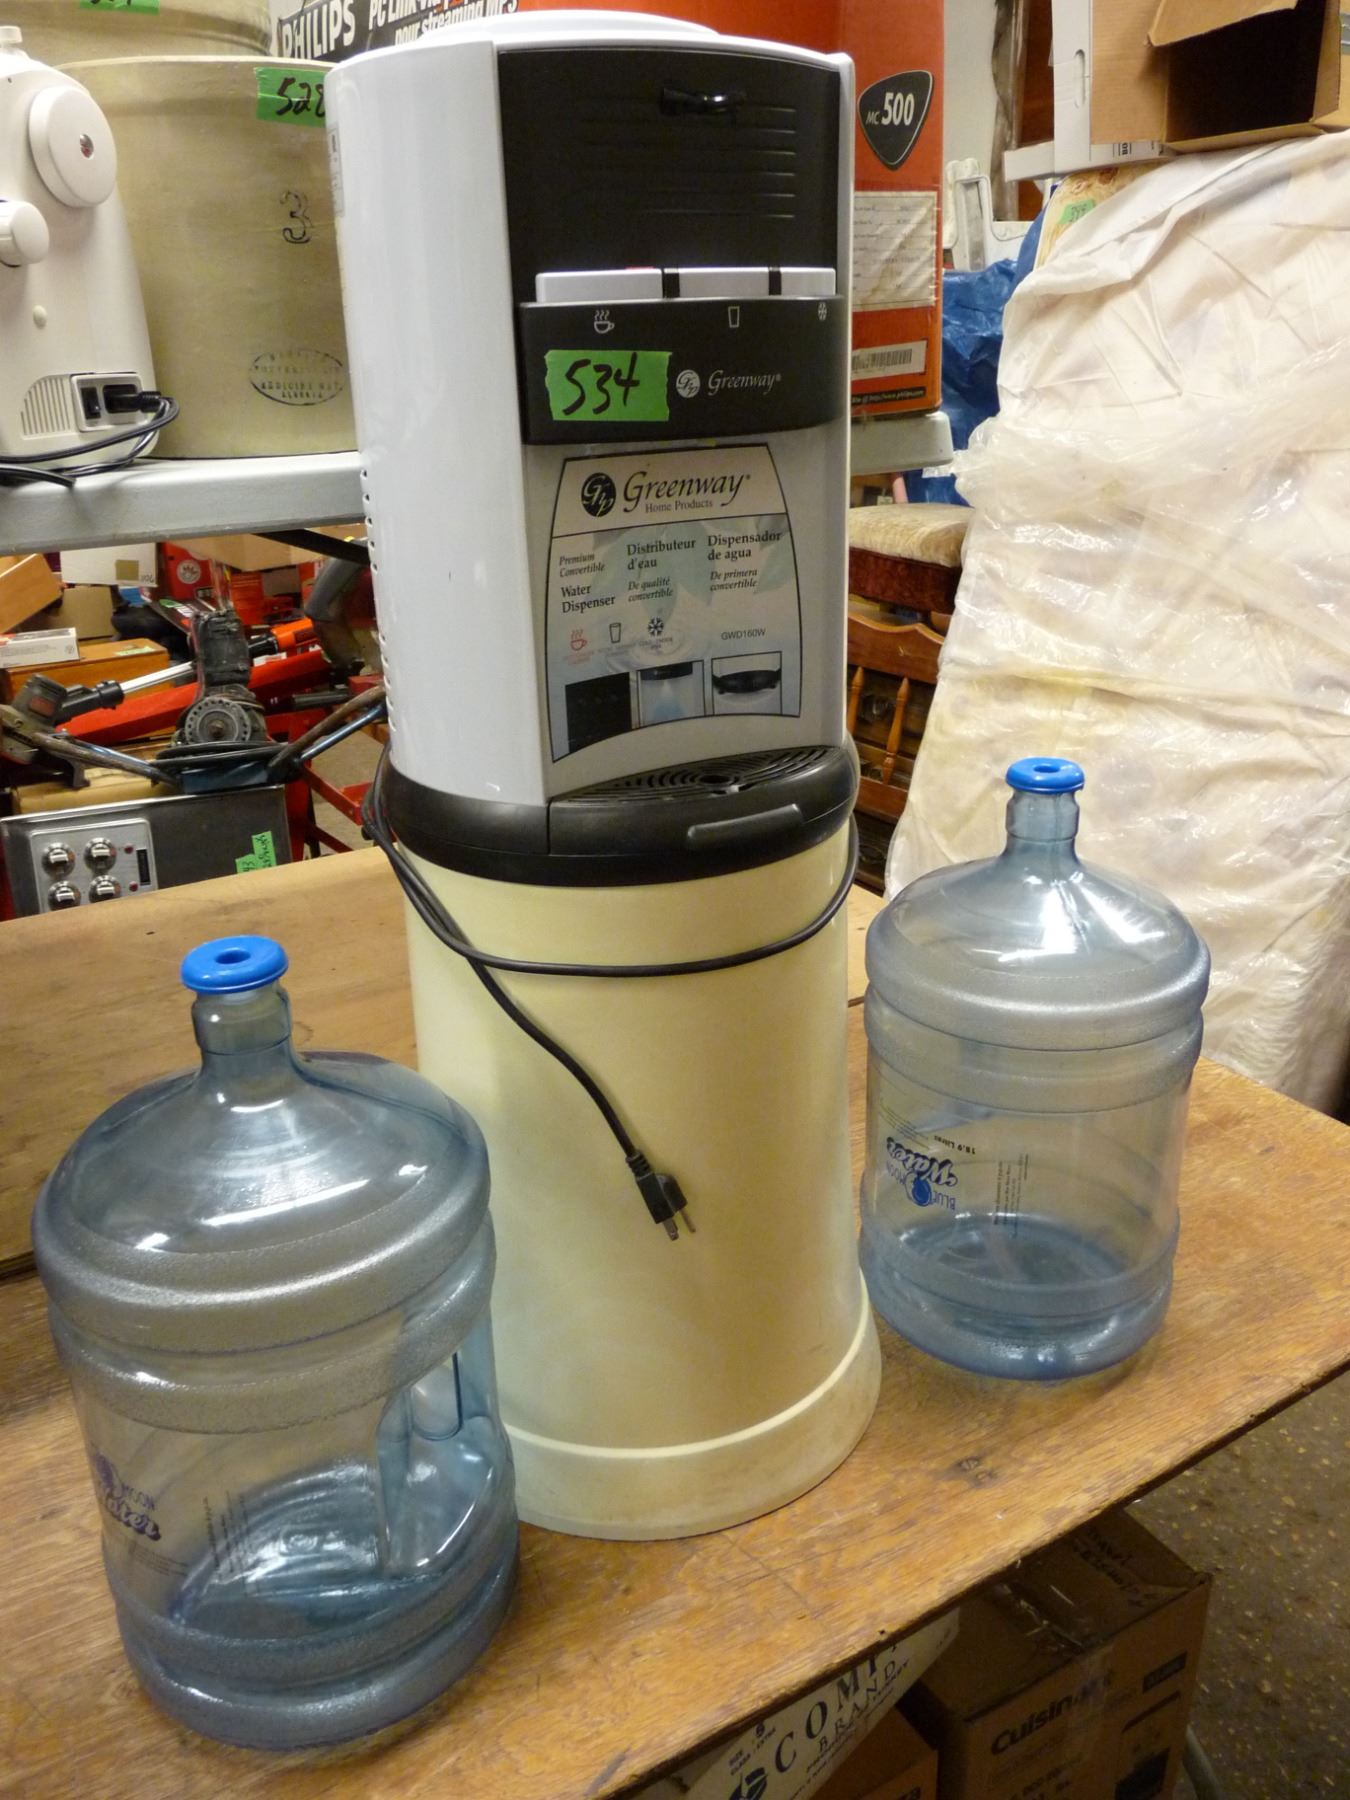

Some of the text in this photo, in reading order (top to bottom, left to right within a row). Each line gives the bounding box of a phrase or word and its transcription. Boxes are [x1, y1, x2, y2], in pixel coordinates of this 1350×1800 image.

[282, 0, 356, 59] PHILIPS
[866, 91, 915, 126] MC 500
[562, 352, 641, 416] 534
[645, 498, 713, 514] Home Products
[626, 538, 697, 556] Distributeur
[707, 530, 783, 549] Dispensador
[559, 551, 595, 567] Premium
[707, 549, 752, 562] de agua
[559, 562, 605, 578] Convertible
[627, 557, 657, 571] d'eau
[628, 575, 671, 591] De qualité
[710, 568, 758, 583] De primera
[560, 584, 592, 599] Water
[709, 578, 758, 592] convertible
[628, 587, 674, 602] convertible
[562, 594, 616, 614] Dispenser
[721, 628, 766, 641] GWD160W
